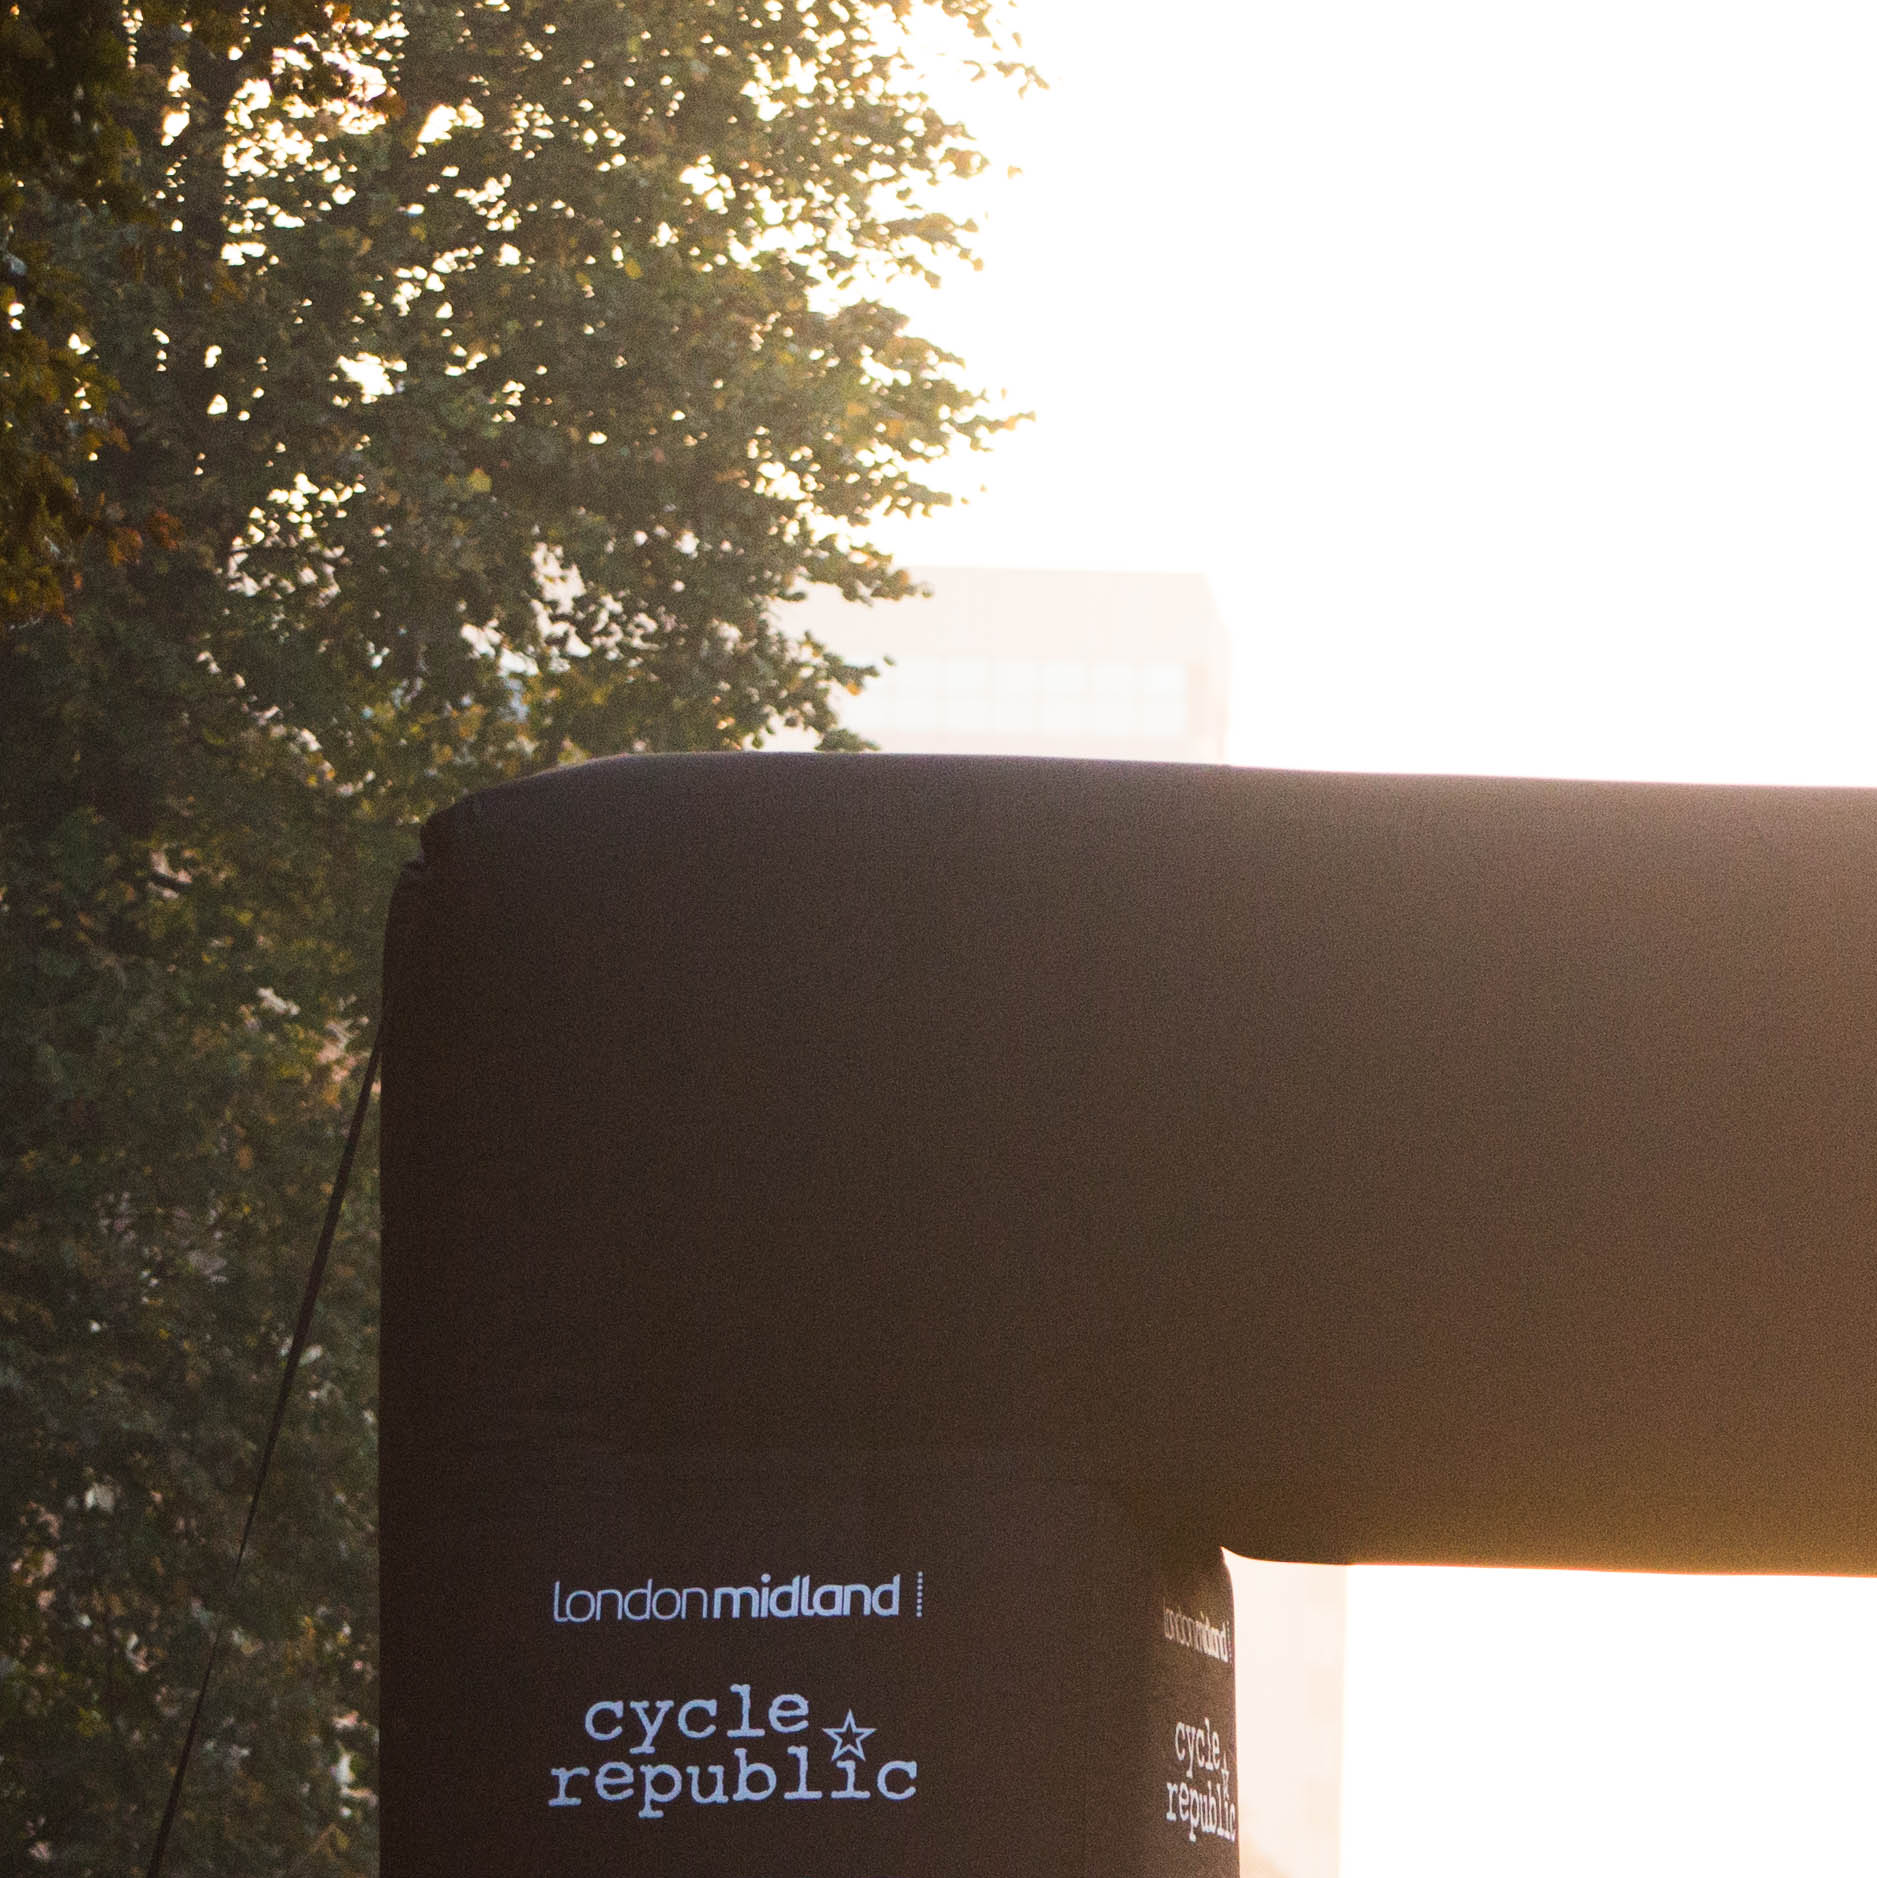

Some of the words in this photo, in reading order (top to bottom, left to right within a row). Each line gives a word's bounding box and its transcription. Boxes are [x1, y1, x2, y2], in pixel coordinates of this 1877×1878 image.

[552, 1572, 901, 1622] londonmidland
[585, 1684, 810, 1754] cycle
[1175, 1716, 1221, 1779] cycle
[548, 1745, 918, 1818] republic
[1166, 1780, 1236, 1843] republic
